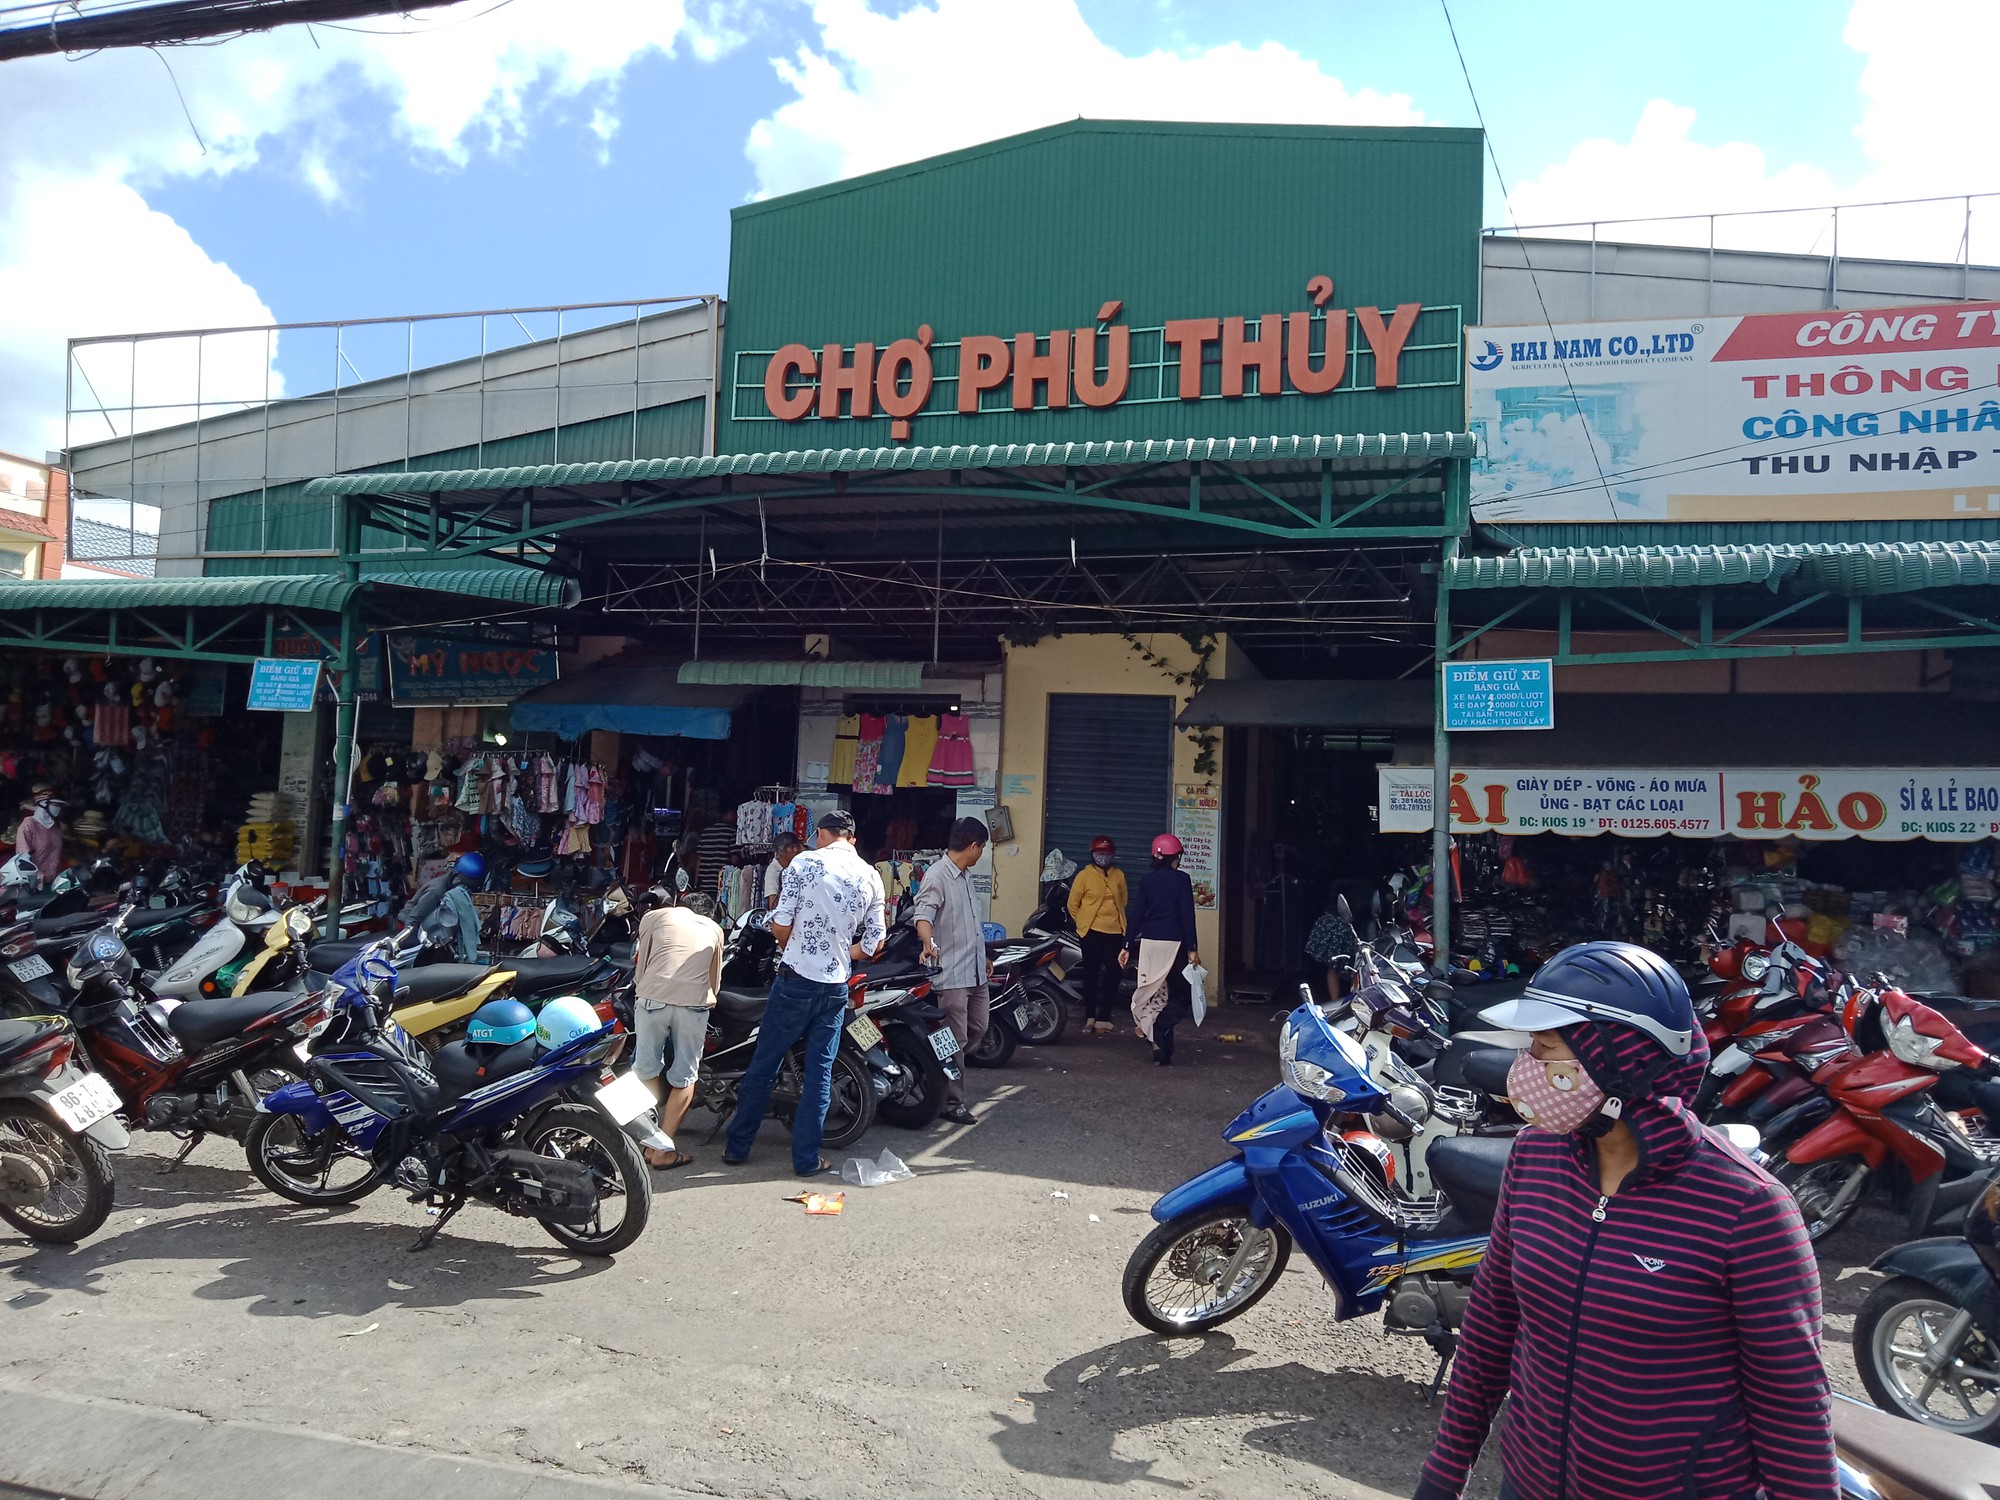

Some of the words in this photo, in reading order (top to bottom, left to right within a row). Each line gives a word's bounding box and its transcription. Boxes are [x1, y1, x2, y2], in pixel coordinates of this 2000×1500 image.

[1795, 311, 1938, 347] CÔNG
[1510, 341, 1547, 362] HAI
[1553, 338, 1602, 360] NAM
[1608, 333, 1695, 358] CO.,LTD
[764, 323, 934, 440] CHỢ
[957, 300, 1130, 413] PHÚ
[1165, 275, 1422, 400] THỦY
[1511, 362, 1566, 371] AGRICULTURAL
[1570, 360, 1584, 368] AND
[1586, 359, 1619, 367] SEAFOOD
[1620, 357, 1655, 366] PRODUCT
[1657, 355, 1694, 364] COMPANY
[1742, 365, 1969, 399] THÔNG
[1742, 409, 1879, 440] CÔNG
[1742, 454, 1830, 475] THU
[1849, 446, 1978, 474] NHẬP
[260, 662, 282, 673] ĐIỂM
[284, 664, 301, 675] GIỮ
[302, 667, 314, 675] XE
[459, 648, 547, 679] NGỌC
[1453, 666, 1489, 682] ĐIỂM
[1493, 668, 1517, 680] GIỮ
[1521, 670, 1541, 680] XE
[1503, 682, 1520, 691] GIÁ
[1415, 789, 1431, 799] LỘC
[1516, 777, 1548, 792] GIÀY
[1554, 777, 1583, 792] DÉP
[1596, 777, 1636, 792] VÕNG
[1650, 777, 1670, 792] ÁO
[1674, 779, 1707, 793] MƯA
[1900, 779, 1915, 811] SỈ
[1921, 787, 1933, 811] &
[1938, 778, 1958, 811] LẺ
[1965, 787, 1999, 811] BAO
[1540, 794, 1569, 810] ỦNG
[1583, 798, 1611, 813] BẠT
[1616, 796, 1645, 811] CÁC
[1650, 799, 1684, 814] LOẠI
[1737, 774, 1888, 831] HẢO
[1519, 817, 1538, 827] ĐC:
[1542, 817, 1568, 827] KIOS
[1572, 817, 1586, 828] 19
[1598, 818, 1618, 828] ĐT:
[1621, 818, 1710, 830] 0125.605.4577
[1901, 822, 1922, 833] ĐC:
[1926, 822, 1955, 833] KIOS
[1960, 822, 1976, 833] 22
[1990, 822, 2000, 833] Đ
[472, 1028, 494, 1038] ATGT
[1298, 1193, 1339, 1212] SUZUKI
[1643, 1256, 1665, 1266] PONY
